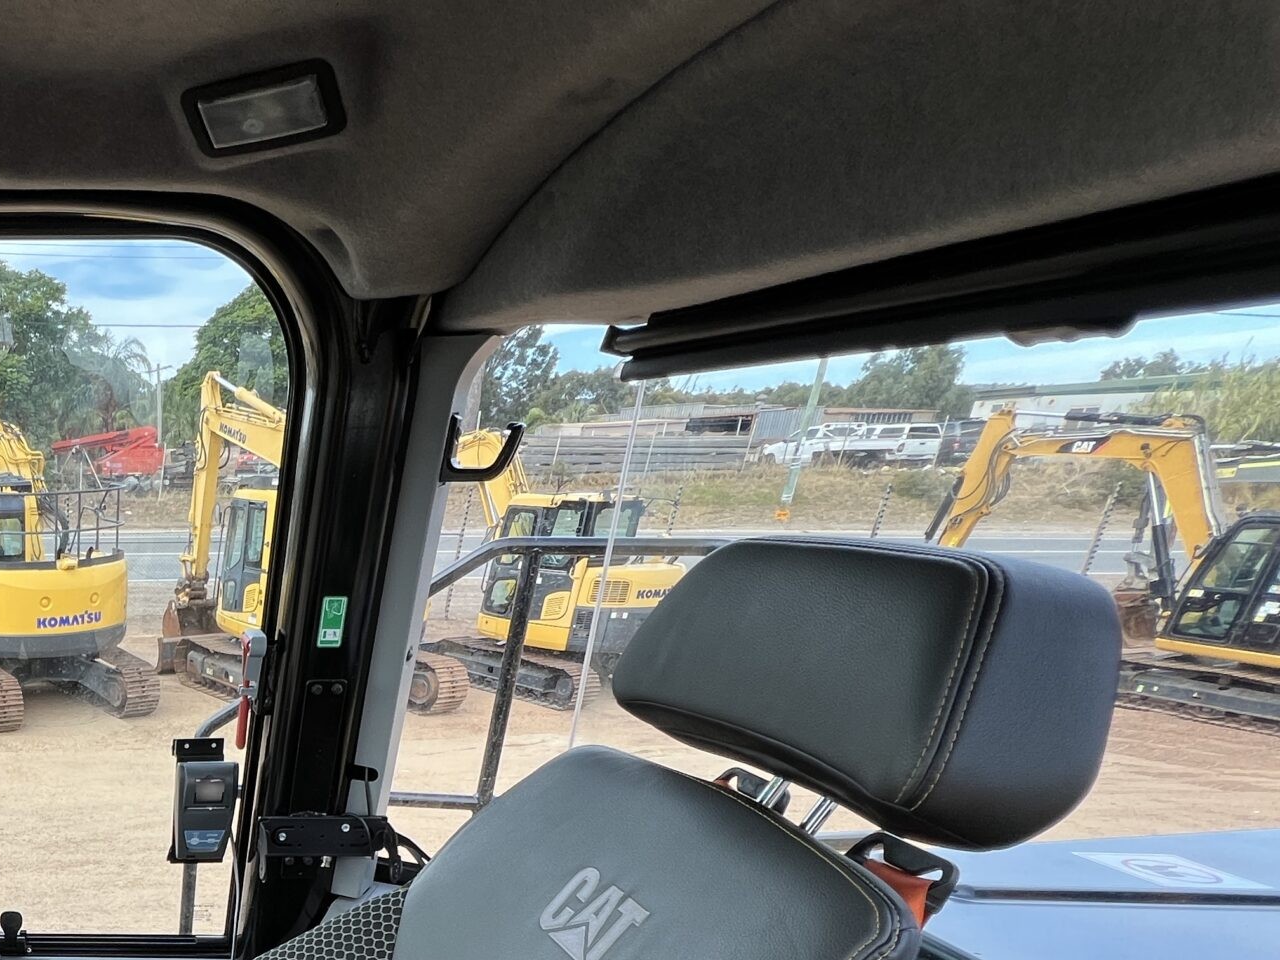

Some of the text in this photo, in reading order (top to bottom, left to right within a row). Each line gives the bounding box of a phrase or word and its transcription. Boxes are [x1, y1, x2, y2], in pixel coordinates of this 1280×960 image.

[219, 421, 247, 444] KOMATSU
[1071, 441, 1096, 453] CAT
[36, 610, 102, 629] KOMATSU
